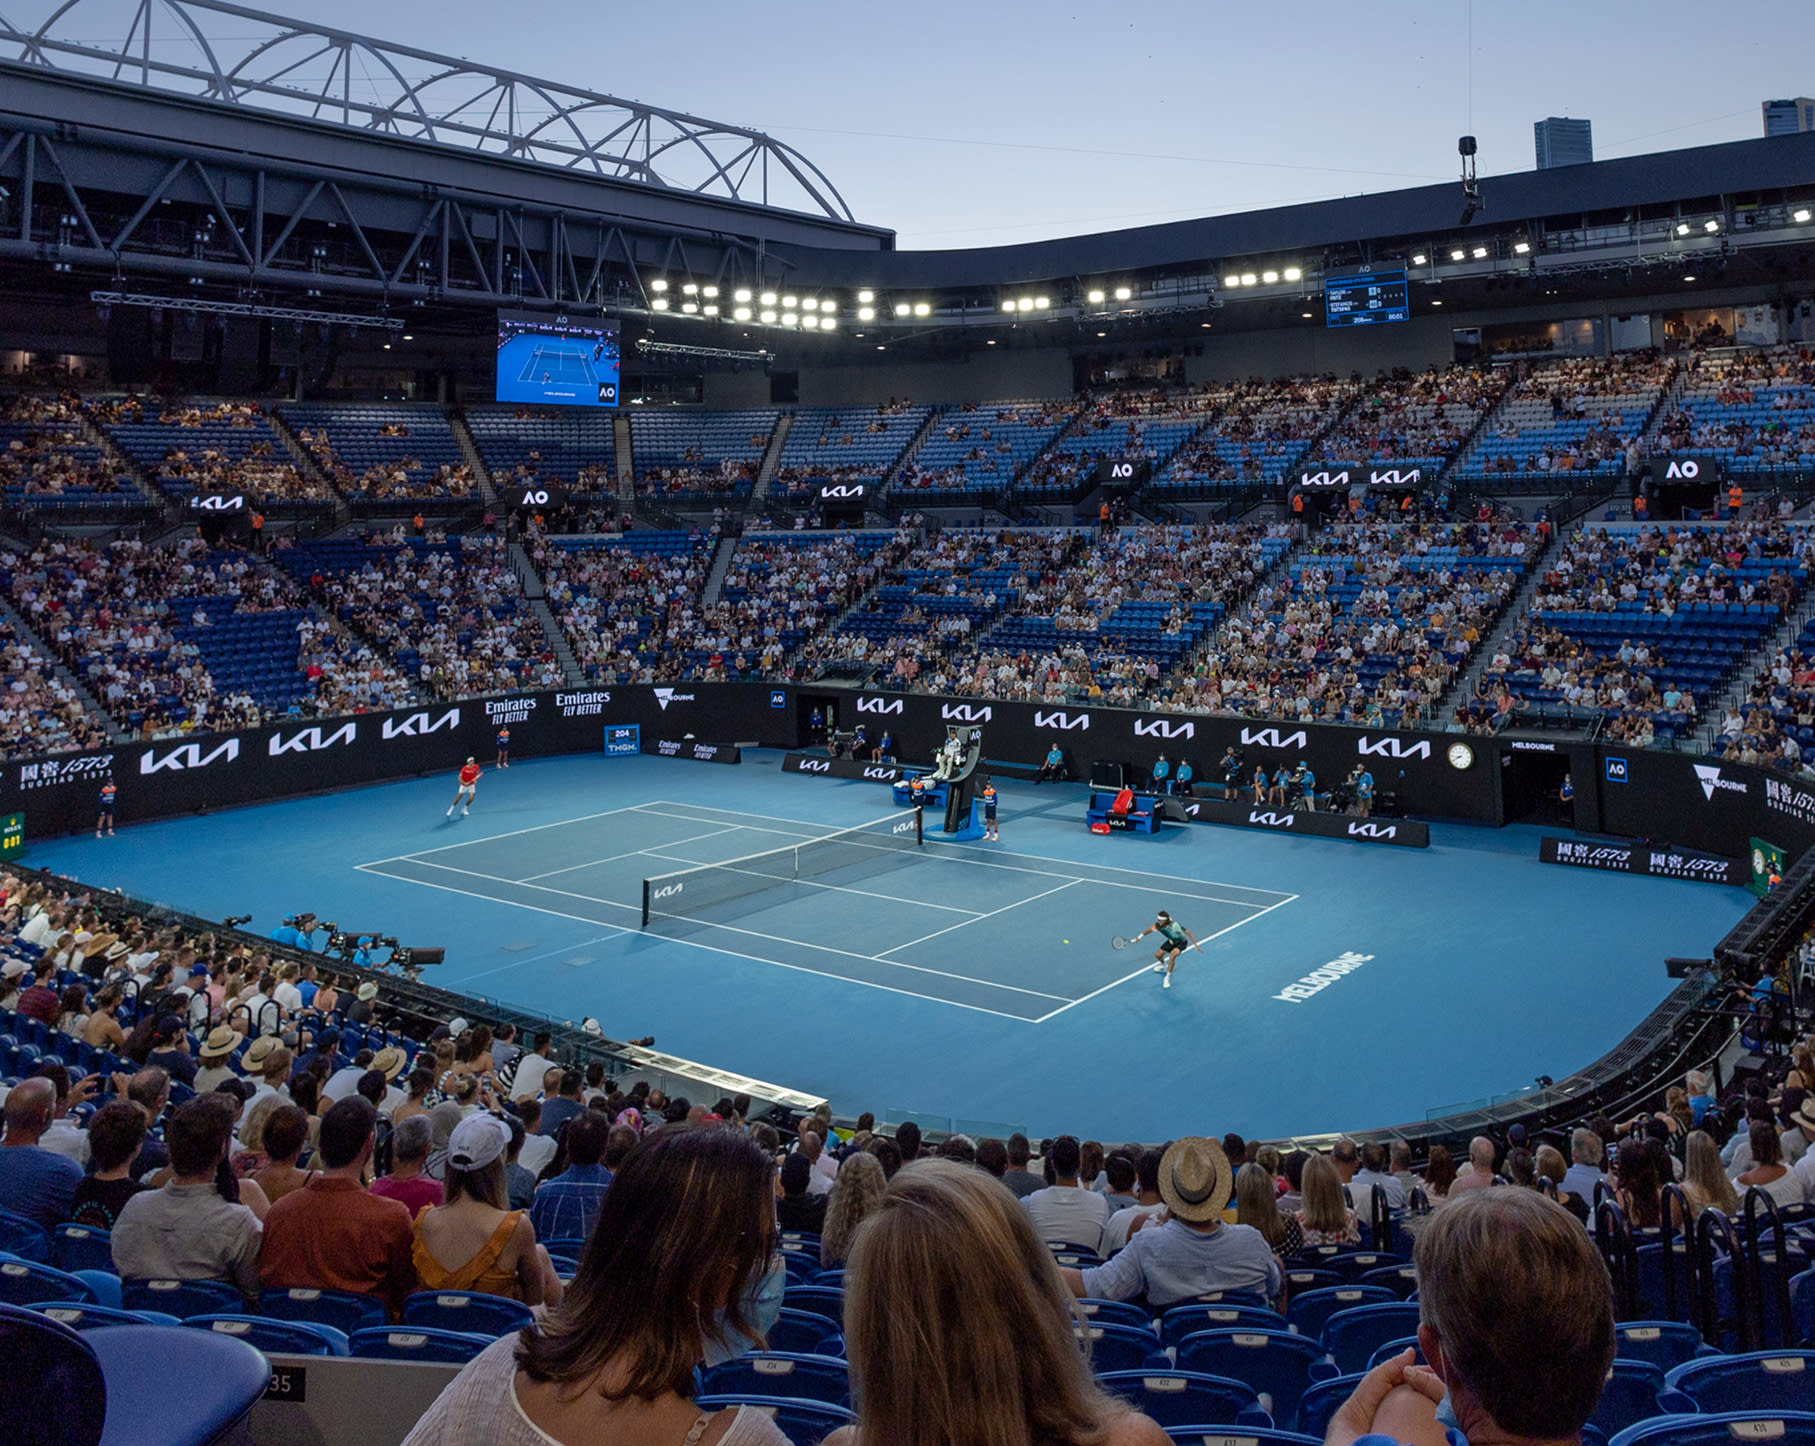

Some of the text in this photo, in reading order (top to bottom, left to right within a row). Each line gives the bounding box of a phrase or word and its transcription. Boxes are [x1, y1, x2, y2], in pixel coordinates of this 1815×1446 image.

[599, 387, 615, 398] AO
[1112, 463, 1133, 478] AO
[1301, 469, 1420, 486] KIA KIA
[1666, 461, 1699, 479] AO
[523, 490, 549, 505] AO
[821, 485, 864, 498] KIA
[191, 496, 243, 510] KIA
[485, 698, 537, 715] Emirates
[555, 691, 611, 707] Emirates
[772, 695, 784, 703] AO
[856, 696, 904, 715] KIA
[492, 710, 529, 726] FLY BETTER
[563, 703, 603, 717] FLY BETTER
[941, 703, 992, 722] KIA
[381, 708, 460, 740] KIA
[1034, 711, 1090, 731] KIA
[1134, 718, 1195, 740] KIA
[268, 722, 356, 756] KIA
[970, 730, 982, 741] AO
[1240, 727, 1307, 749] KIA
[1358, 736, 1431, 760] KIA
[1511, 741, 1555, 751] MELBOURNE
[139, 738, 240, 775] KIA
[799, 759, 831, 772] KIA
[863, 765, 897, 780] KIA
[1609, 763, 1625, 775] AO
[1249, 811, 1295, 827] KIA
[1348, 822, 1397, 839] KIA
[654, 882, 684, 900] KIA
[1271, 950, 1376, 1004] MELBOURNE
[270, 1374, 291, 1392] 35
